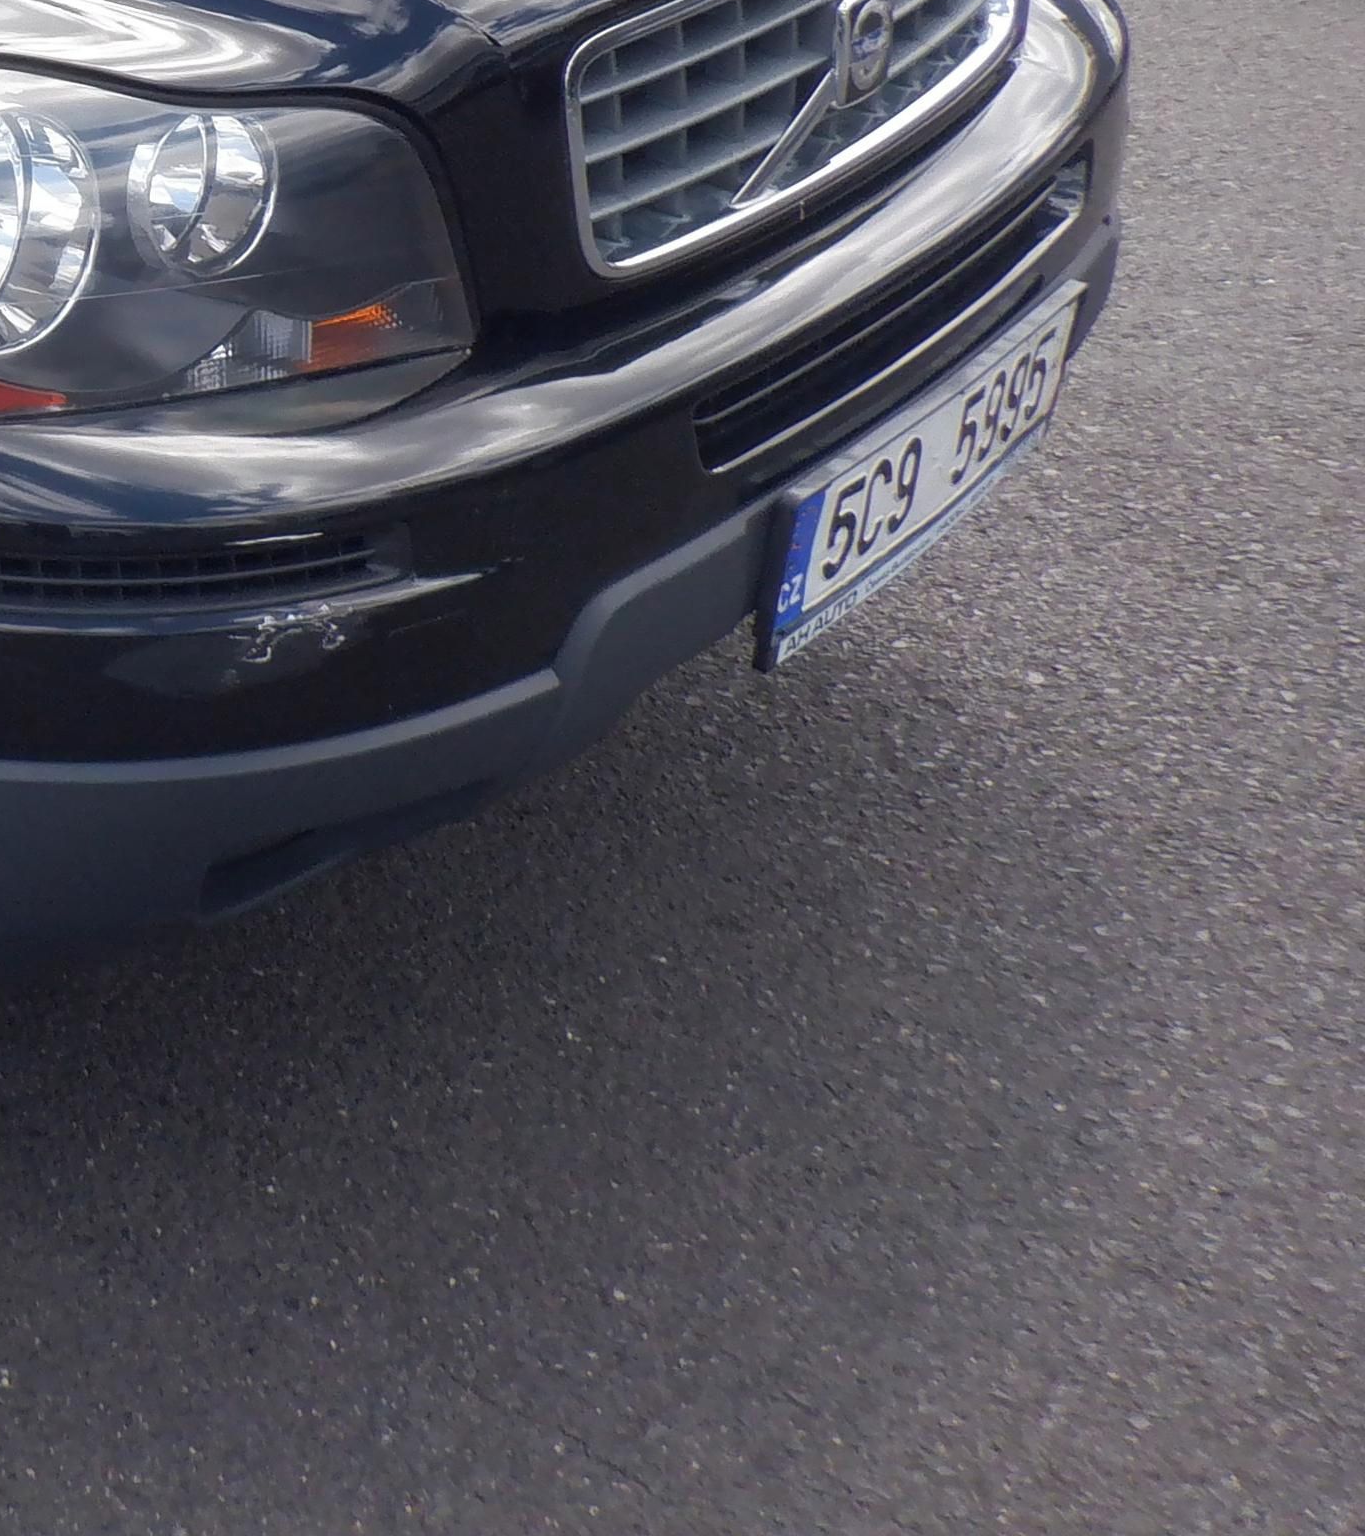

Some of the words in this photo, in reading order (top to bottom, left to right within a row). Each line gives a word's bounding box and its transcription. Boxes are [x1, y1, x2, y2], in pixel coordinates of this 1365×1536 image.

[821, 435, 923, 580] 5C9
[950, 325, 1058, 486] 5995
[776, 573, 804, 614] CZ
